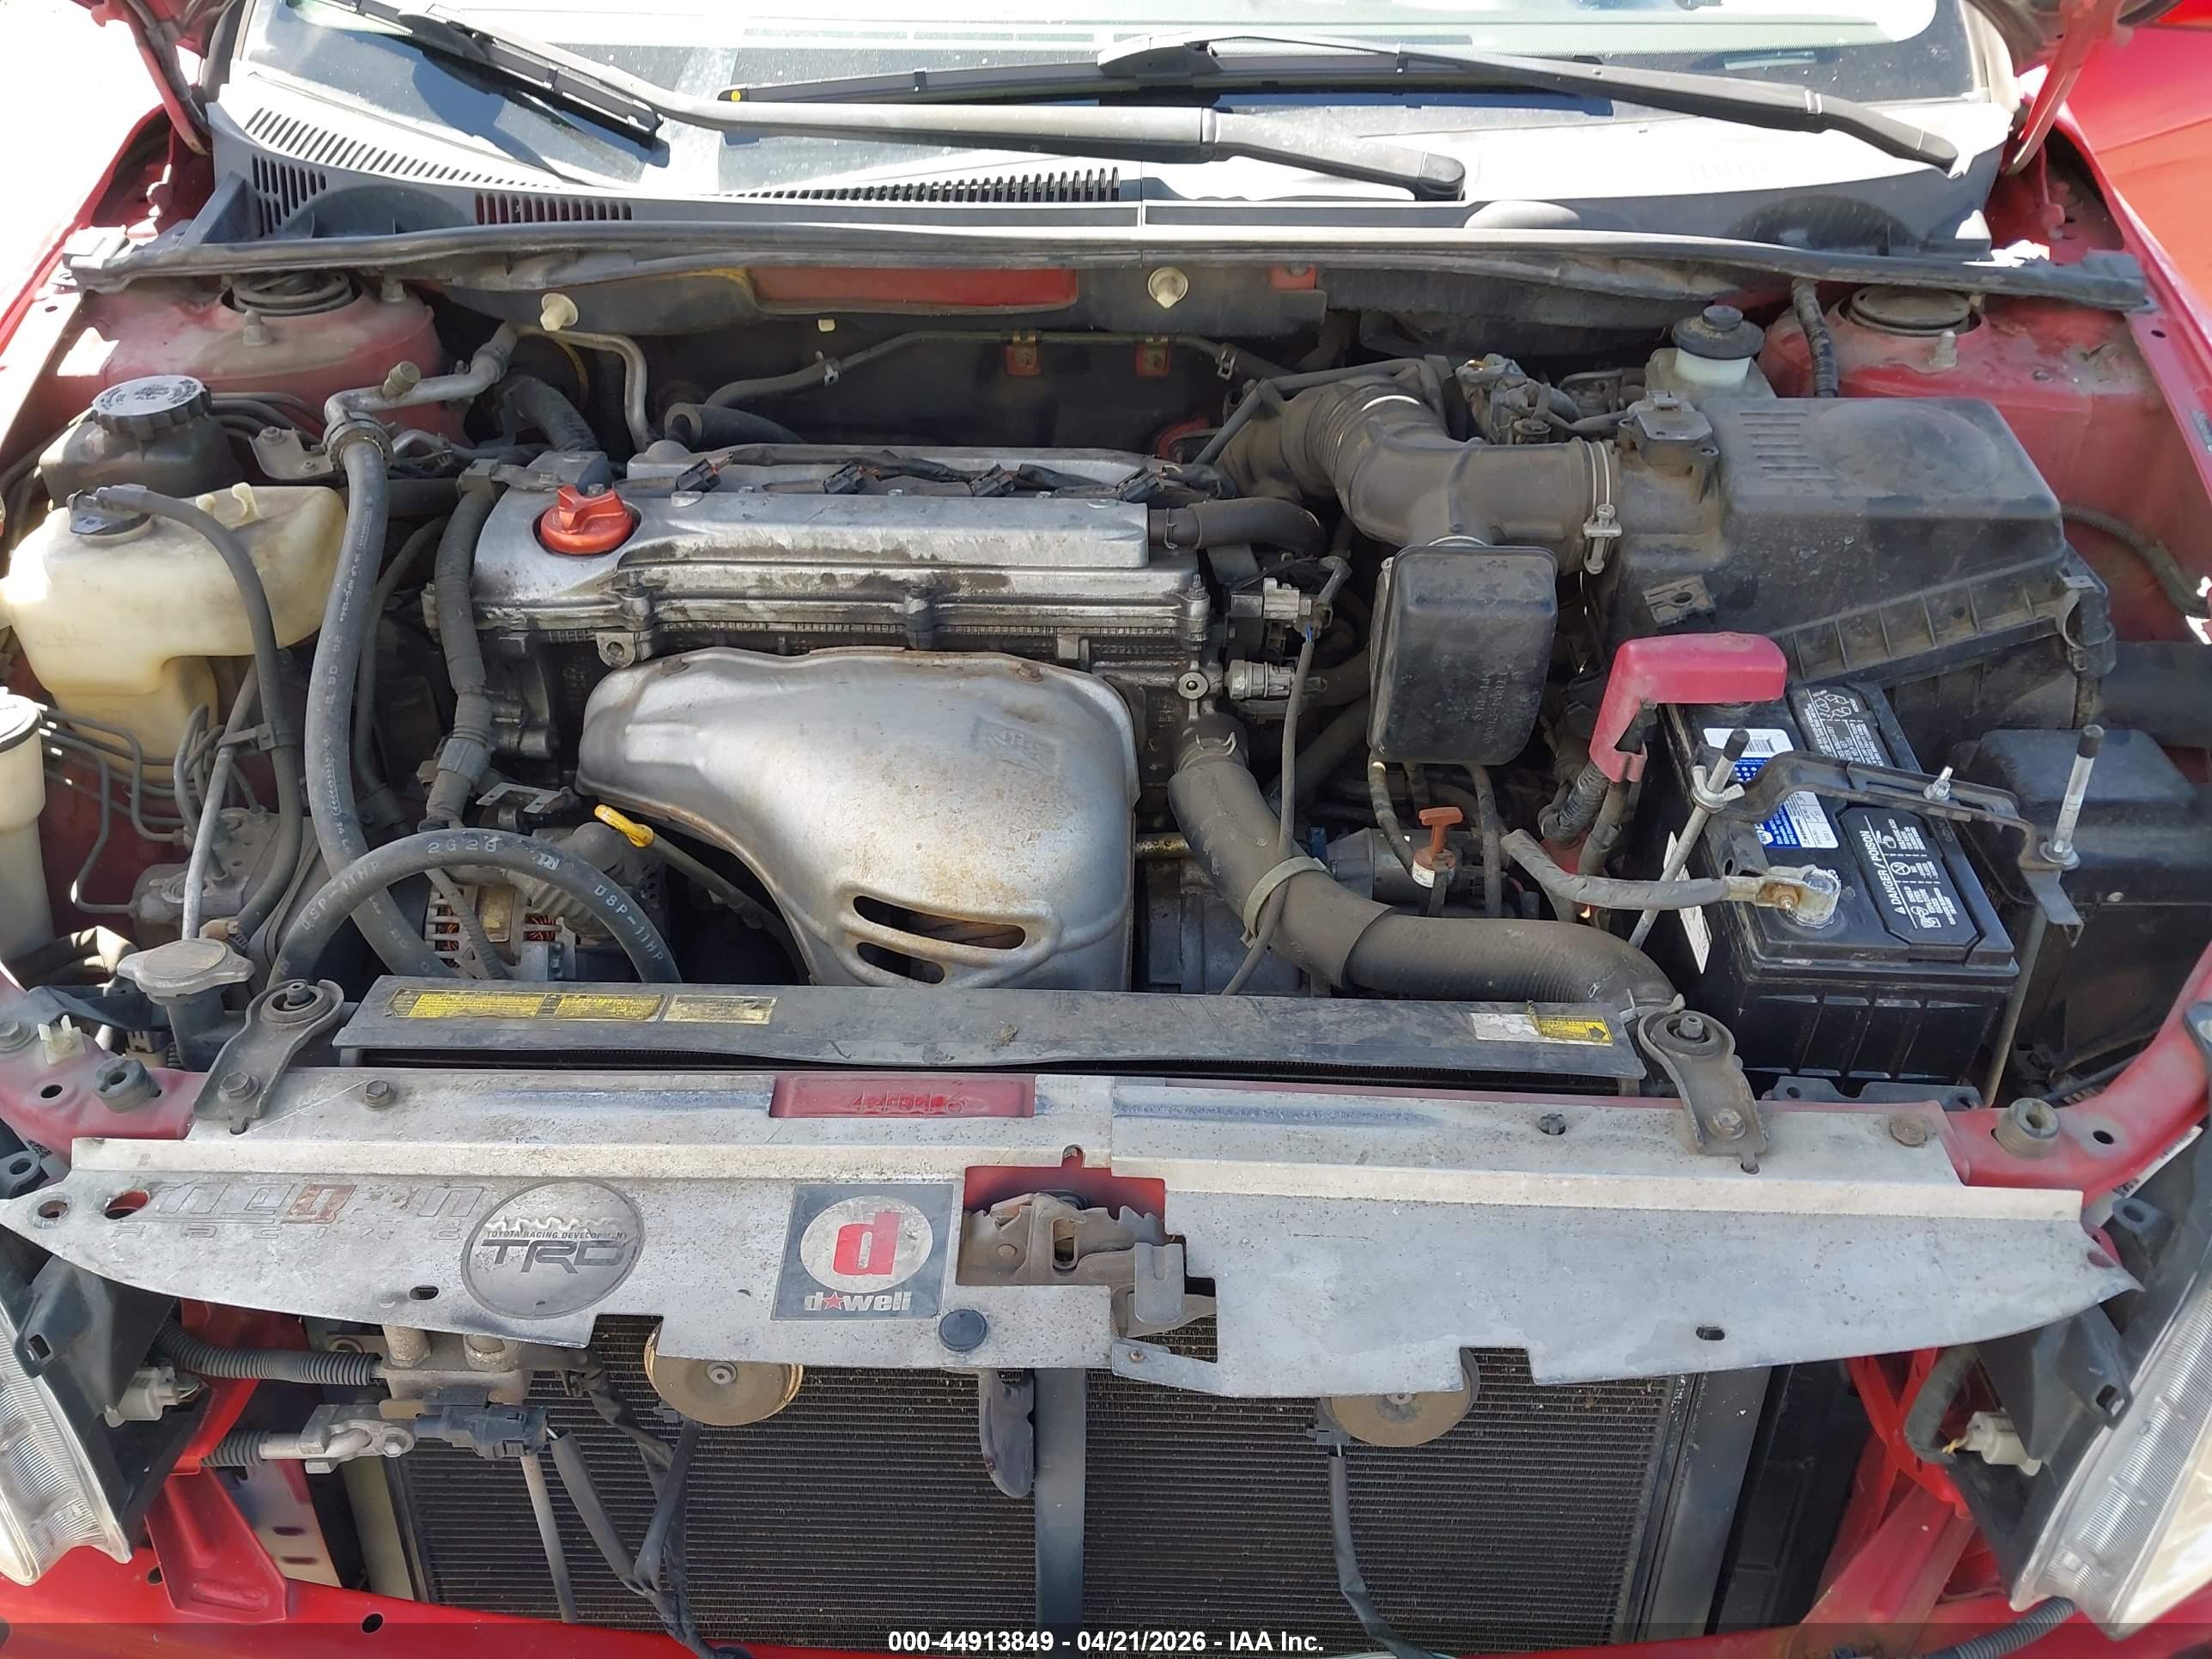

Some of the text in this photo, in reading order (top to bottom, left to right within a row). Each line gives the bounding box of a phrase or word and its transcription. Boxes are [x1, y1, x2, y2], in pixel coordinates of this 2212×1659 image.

[1859, 830, 1882, 861] POISON
[1877, 870, 1902, 905] DANGER
[486, 1230, 521, 1238] TOYOTA
[522, 1231, 558, 1239] RACING
[831, 1211, 902, 1277] d
[481, 1239, 627, 1274] TRD
